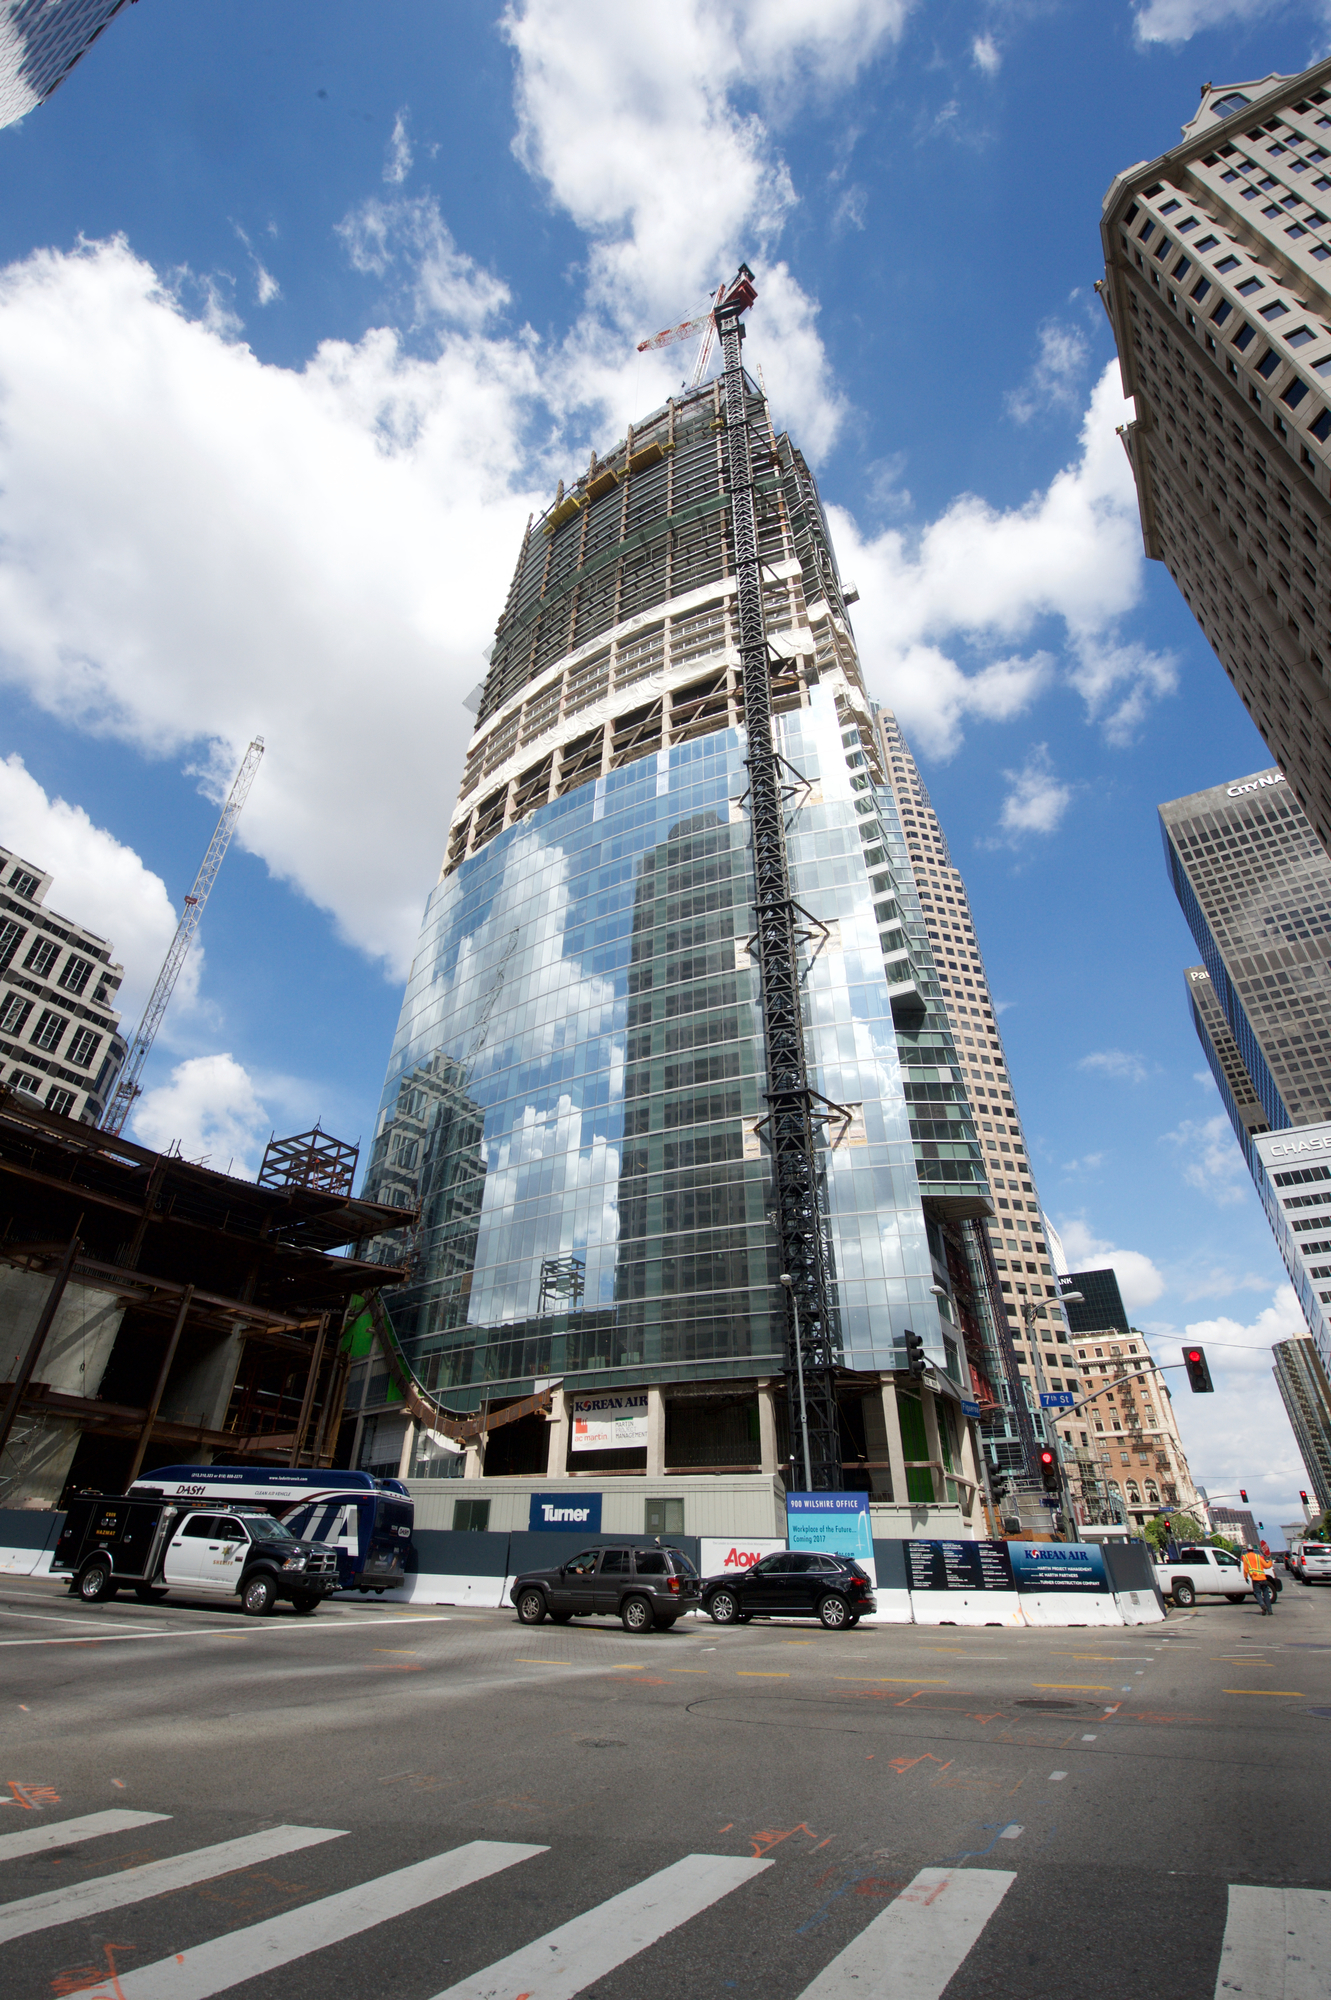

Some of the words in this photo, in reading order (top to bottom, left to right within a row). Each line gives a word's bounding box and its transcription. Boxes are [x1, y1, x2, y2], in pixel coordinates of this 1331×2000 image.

[1270, 1136, 1331, 1157] CHASE
[575, 1398, 623, 1412] KOREAN
[624, 1395, 648, 1407] AIR
[1043, 1395, 1057, 1405] 7th
[1059, 1395, 1070, 1404] St
[584, 1432, 608, 1442] martin
[176, 1485, 206, 1495] DASH
[790, 1500, 802, 1508] 900
[803, 1500, 834, 1508] WILSHIRE
[835, 1500, 858, 1508] OFFICE
[541, 1504, 590, 1522] Turner
[792, 1525, 819, 1534] Workplace
[819, 1525, 825, 1533] of
[825, 1525, 834, 1533] the
[792, 1535, 812, 1544] Coming
[813, 1535, 826, 1543] 2017
[1024, 1549, 1067, 1560] KOREAN
[1067, 1551, 1089, 1560] AIR
